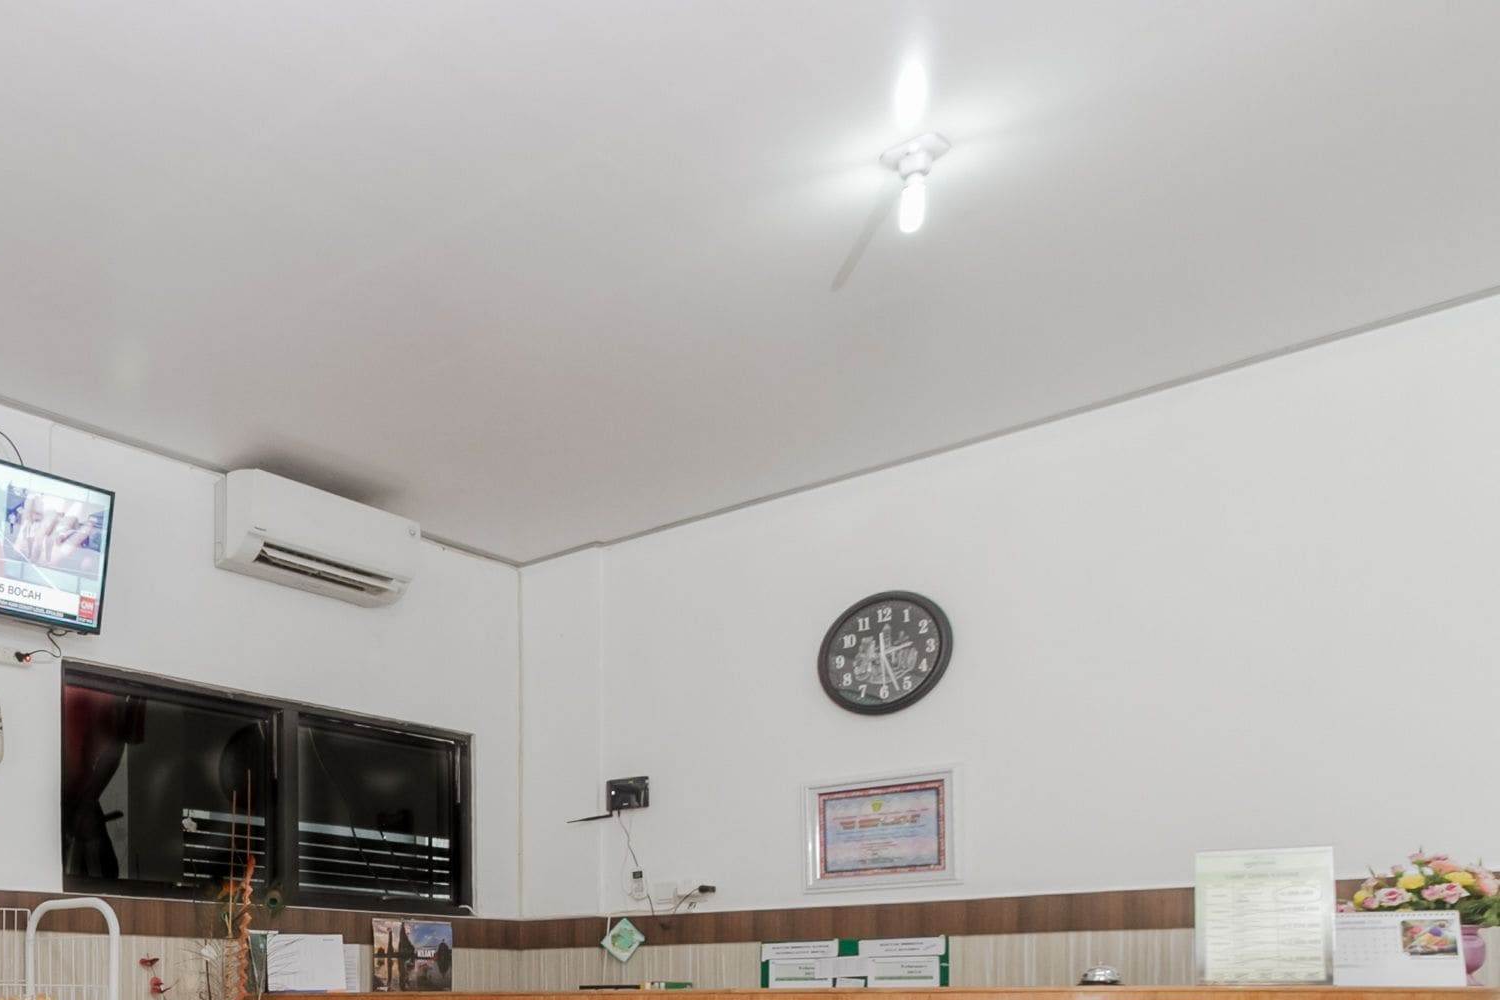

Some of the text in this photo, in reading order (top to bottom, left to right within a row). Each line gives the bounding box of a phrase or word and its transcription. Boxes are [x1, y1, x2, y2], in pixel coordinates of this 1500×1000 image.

[0, 583, 5, 593] 5
[7, 585, 42, 600] BOCAH
[877, 607, 892, 623] 12
[903, 609, 910, 622] 1
[857, 617, 870, 631] 11
[918, 619, 929, 634] 2
[843, 634, 856, 648] 10
[925, 638, 936, 653] 3
[835, 655, 845, 669] 9
[918, 658, 928, 672] 4
[842, 673, 852, 686] 8
[902, 676, 912, 690] 5
[858, 684, 867, 698] 7
[879, 685, 889, 699] 6
